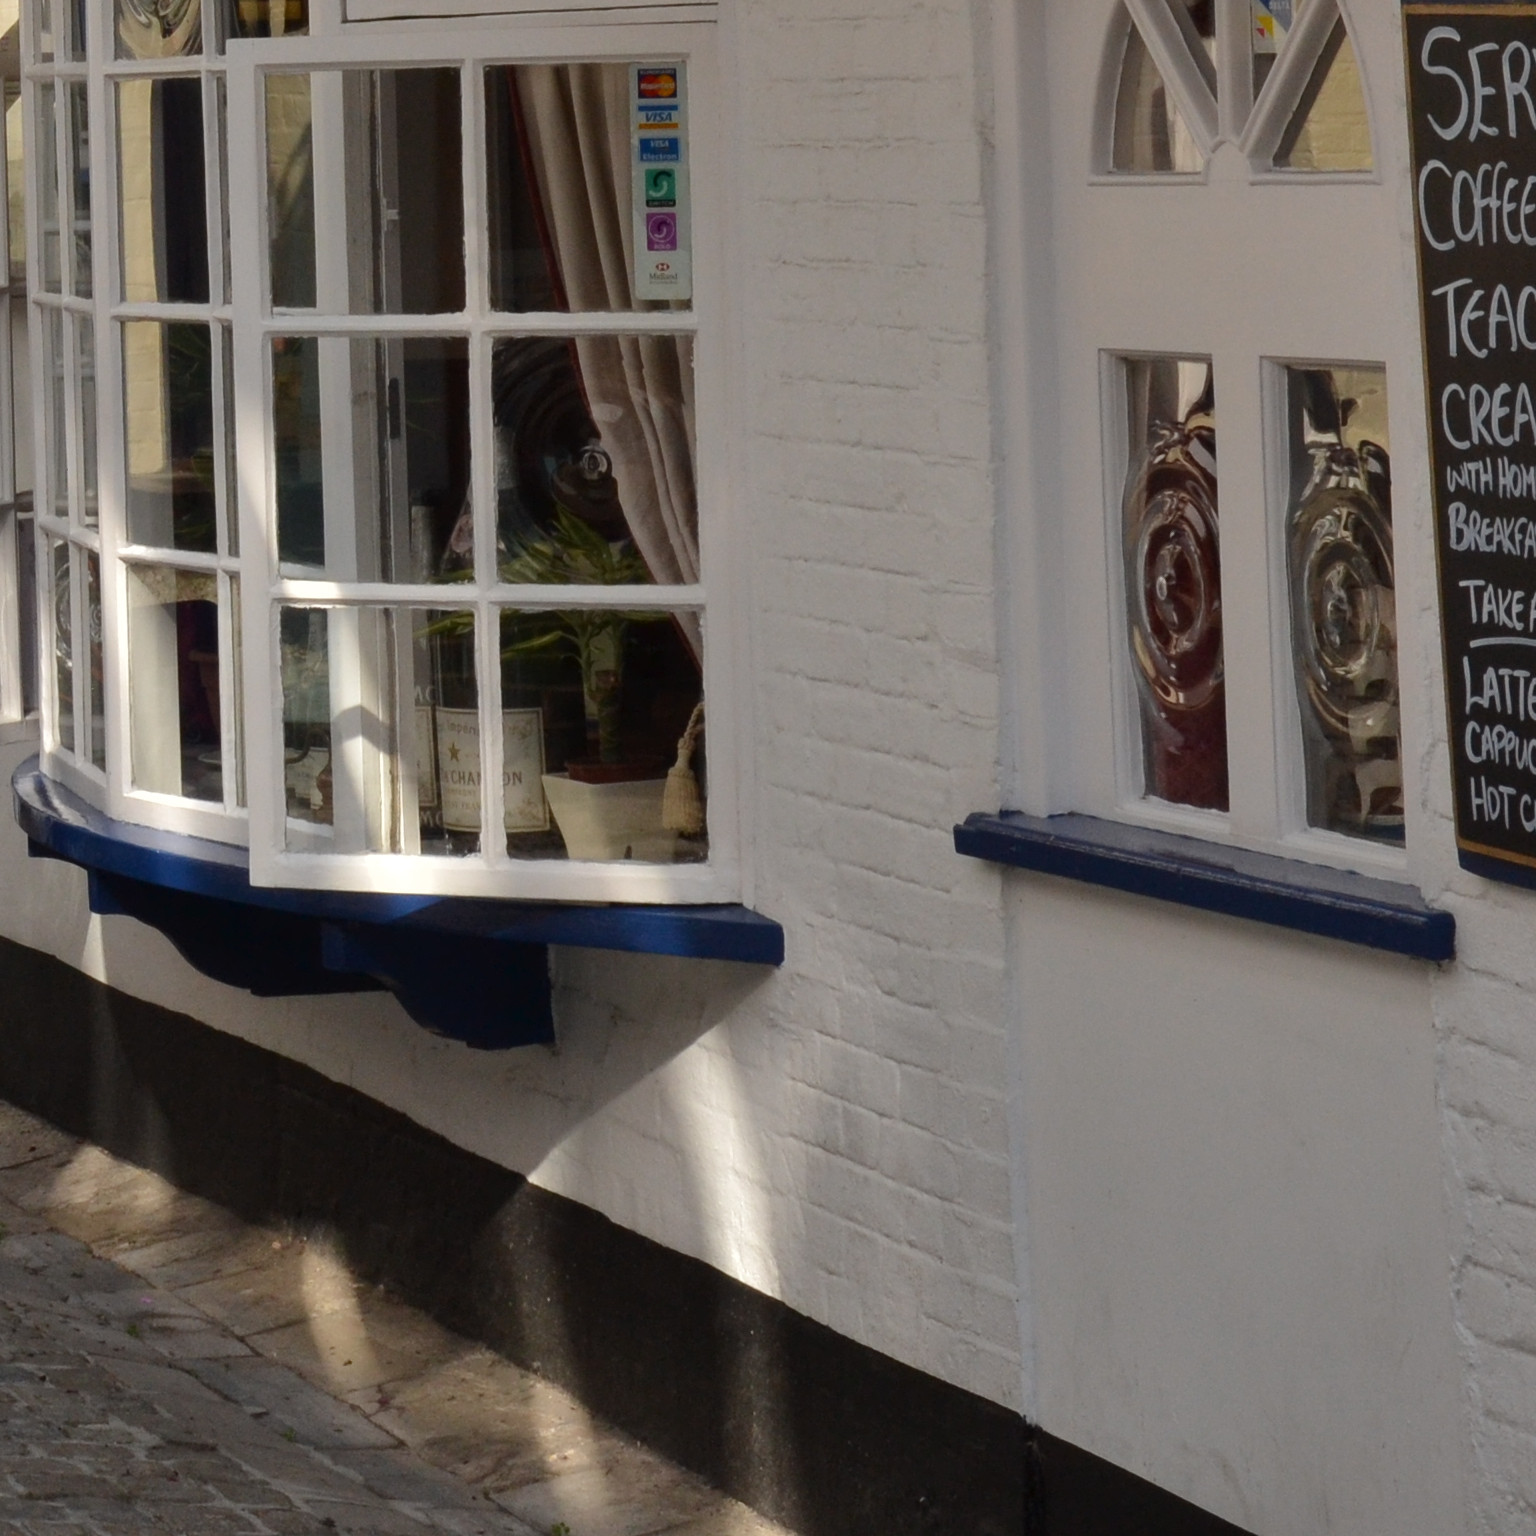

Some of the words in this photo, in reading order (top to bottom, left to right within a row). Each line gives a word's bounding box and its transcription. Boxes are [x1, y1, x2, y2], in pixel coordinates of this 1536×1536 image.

[645, 111, 673, 122] VISA
[650, 140, 669, 148] VISA
[1446, 456, 1493, 495] WITH
[1470, 775, 1517, 831] HOT
